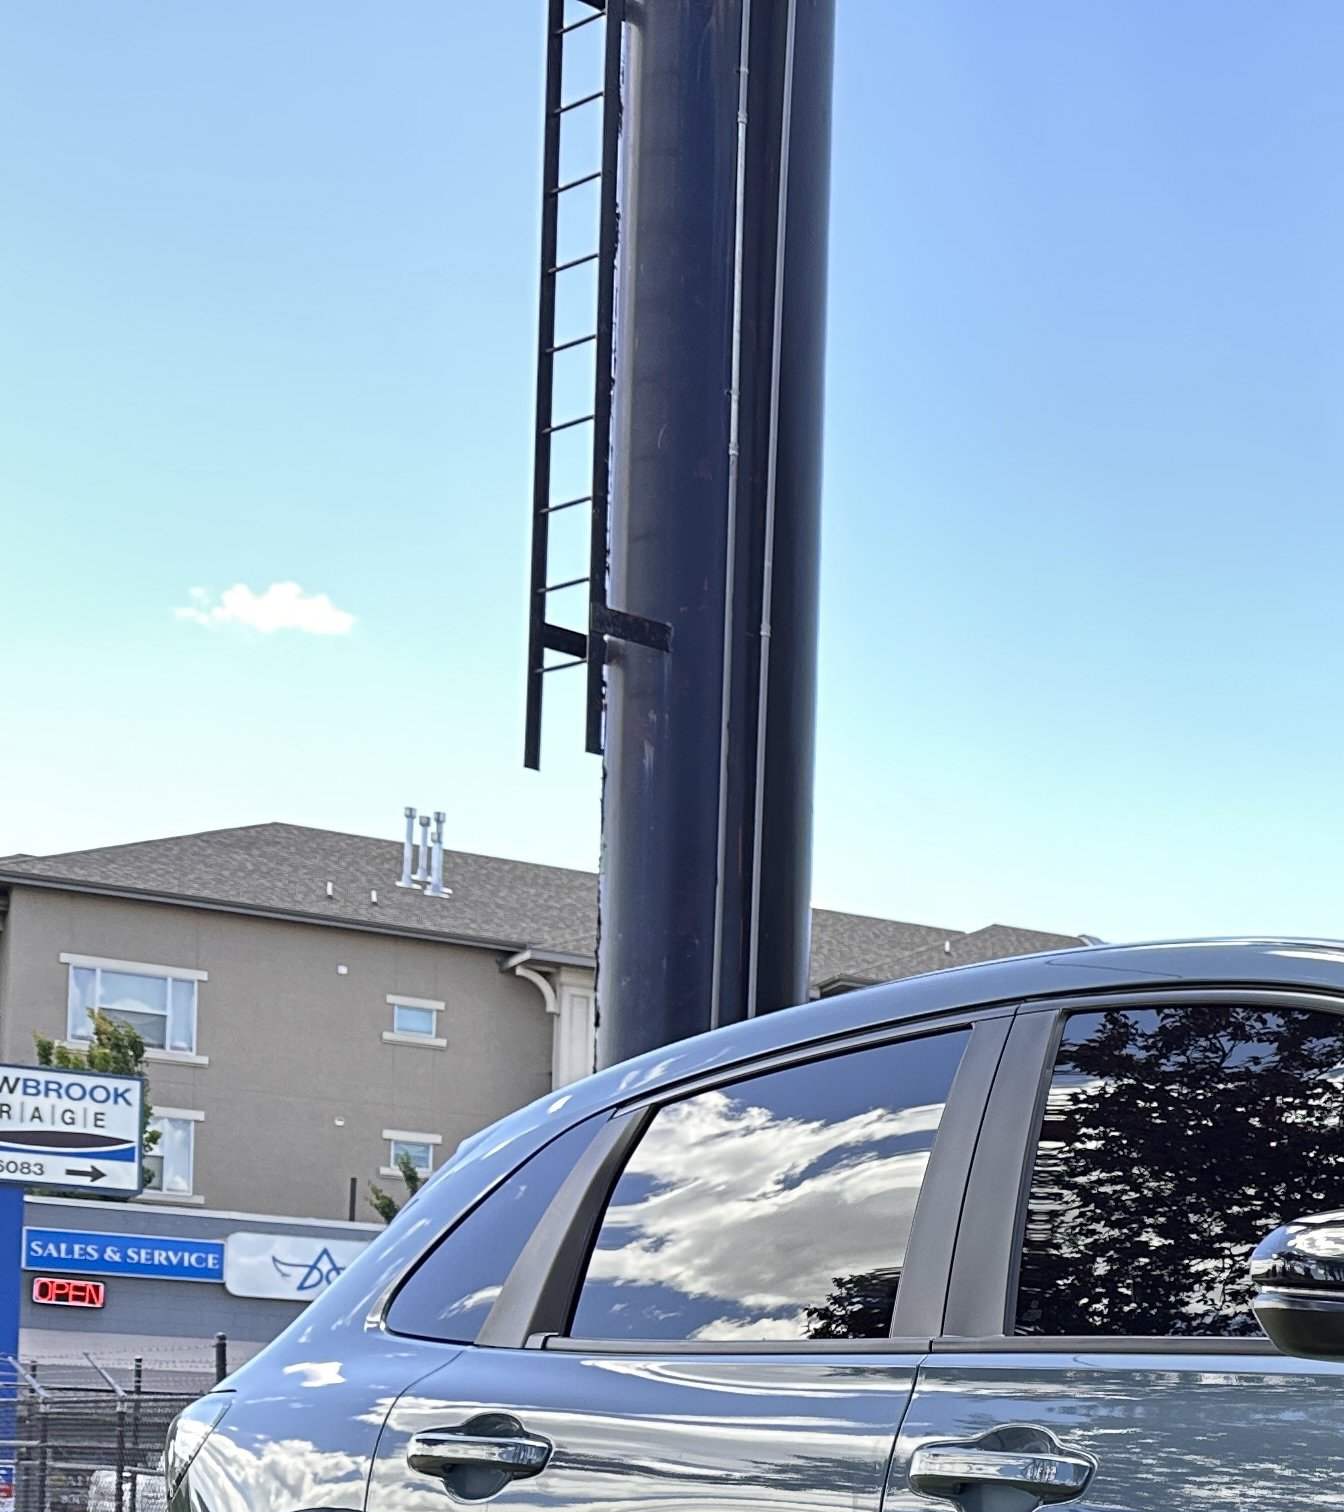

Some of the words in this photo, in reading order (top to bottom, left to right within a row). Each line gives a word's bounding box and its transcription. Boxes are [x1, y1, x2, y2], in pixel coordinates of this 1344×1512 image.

[30, 1240, 99, 1260] SALES
[103, 1245, 122, 1262] &
[126, 1247, 219, 1269] SERVICE
[36, 1279, 103, 1305] OPEN
